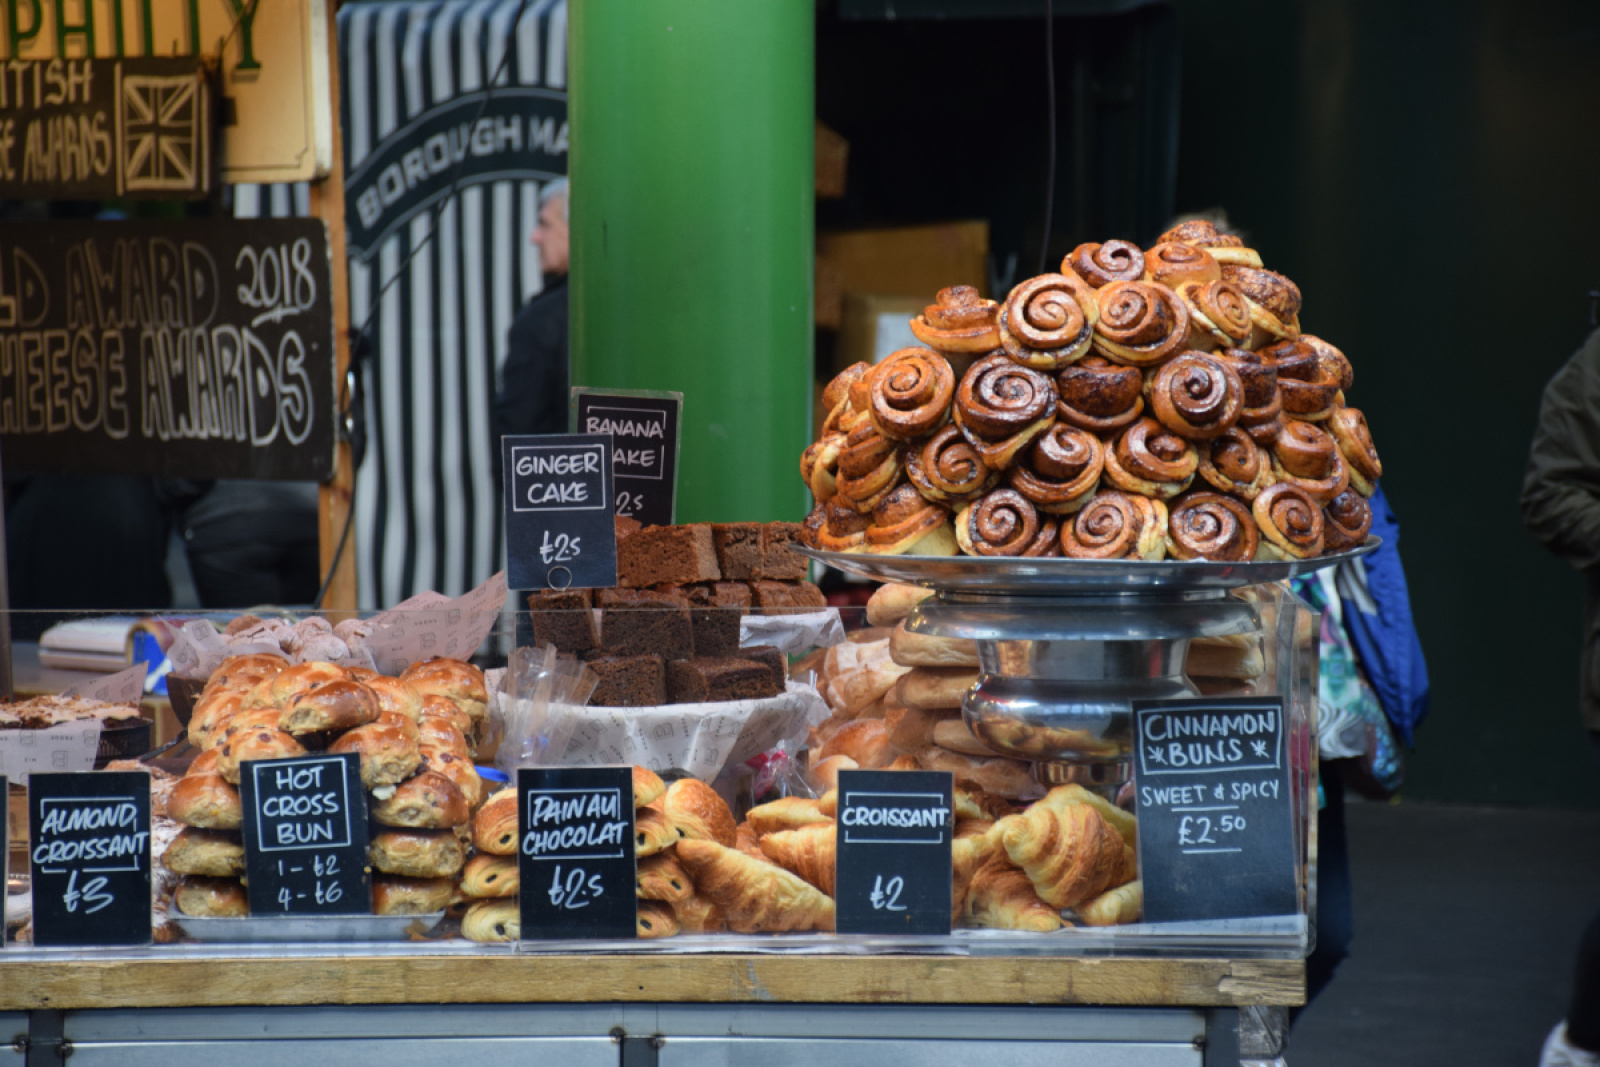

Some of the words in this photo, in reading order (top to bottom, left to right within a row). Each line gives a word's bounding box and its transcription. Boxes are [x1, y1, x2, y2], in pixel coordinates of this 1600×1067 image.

[356, 114, 522, 229] BOROUGH
[66, 237, 219, 330] AWARD
[236, 237, 317, 311] 2018
[140, 324, 314, 446] AWARDS
[586, 416, 664, 439] BANANA
[515, 452, 600, 476] GINGER
[613, 449, 656, 467] AKE
[527, 481, 589, 504] CAKE
[1144, 711, 1275, 741] CINNAMON
[276, 765, 325, 791] HOT
[1141, 785, 1207, 807] SWEET
[1231, 779, 1280, 801] SPICY
[41, 803, 138, 835] ALMOND
[263, 792, 340, 817] CROSS
[841, 806, 950, 828] CROISSANT
[276, 819, 333, 844] BUN
[522, 820, 629, 855] CHOCOLAT
[1178, 815, 1247, 846] £2.50
[32, 832, 150, 864] CROISSANT
[278, 859, 284, 876] 1
[313, 854, 341, 877] £2
[63, 869, 114, 915] £3
[278, 887, 292, 911] 4
[315, 880, 344, 905] £6
[869, 875, 908, 911] £2
